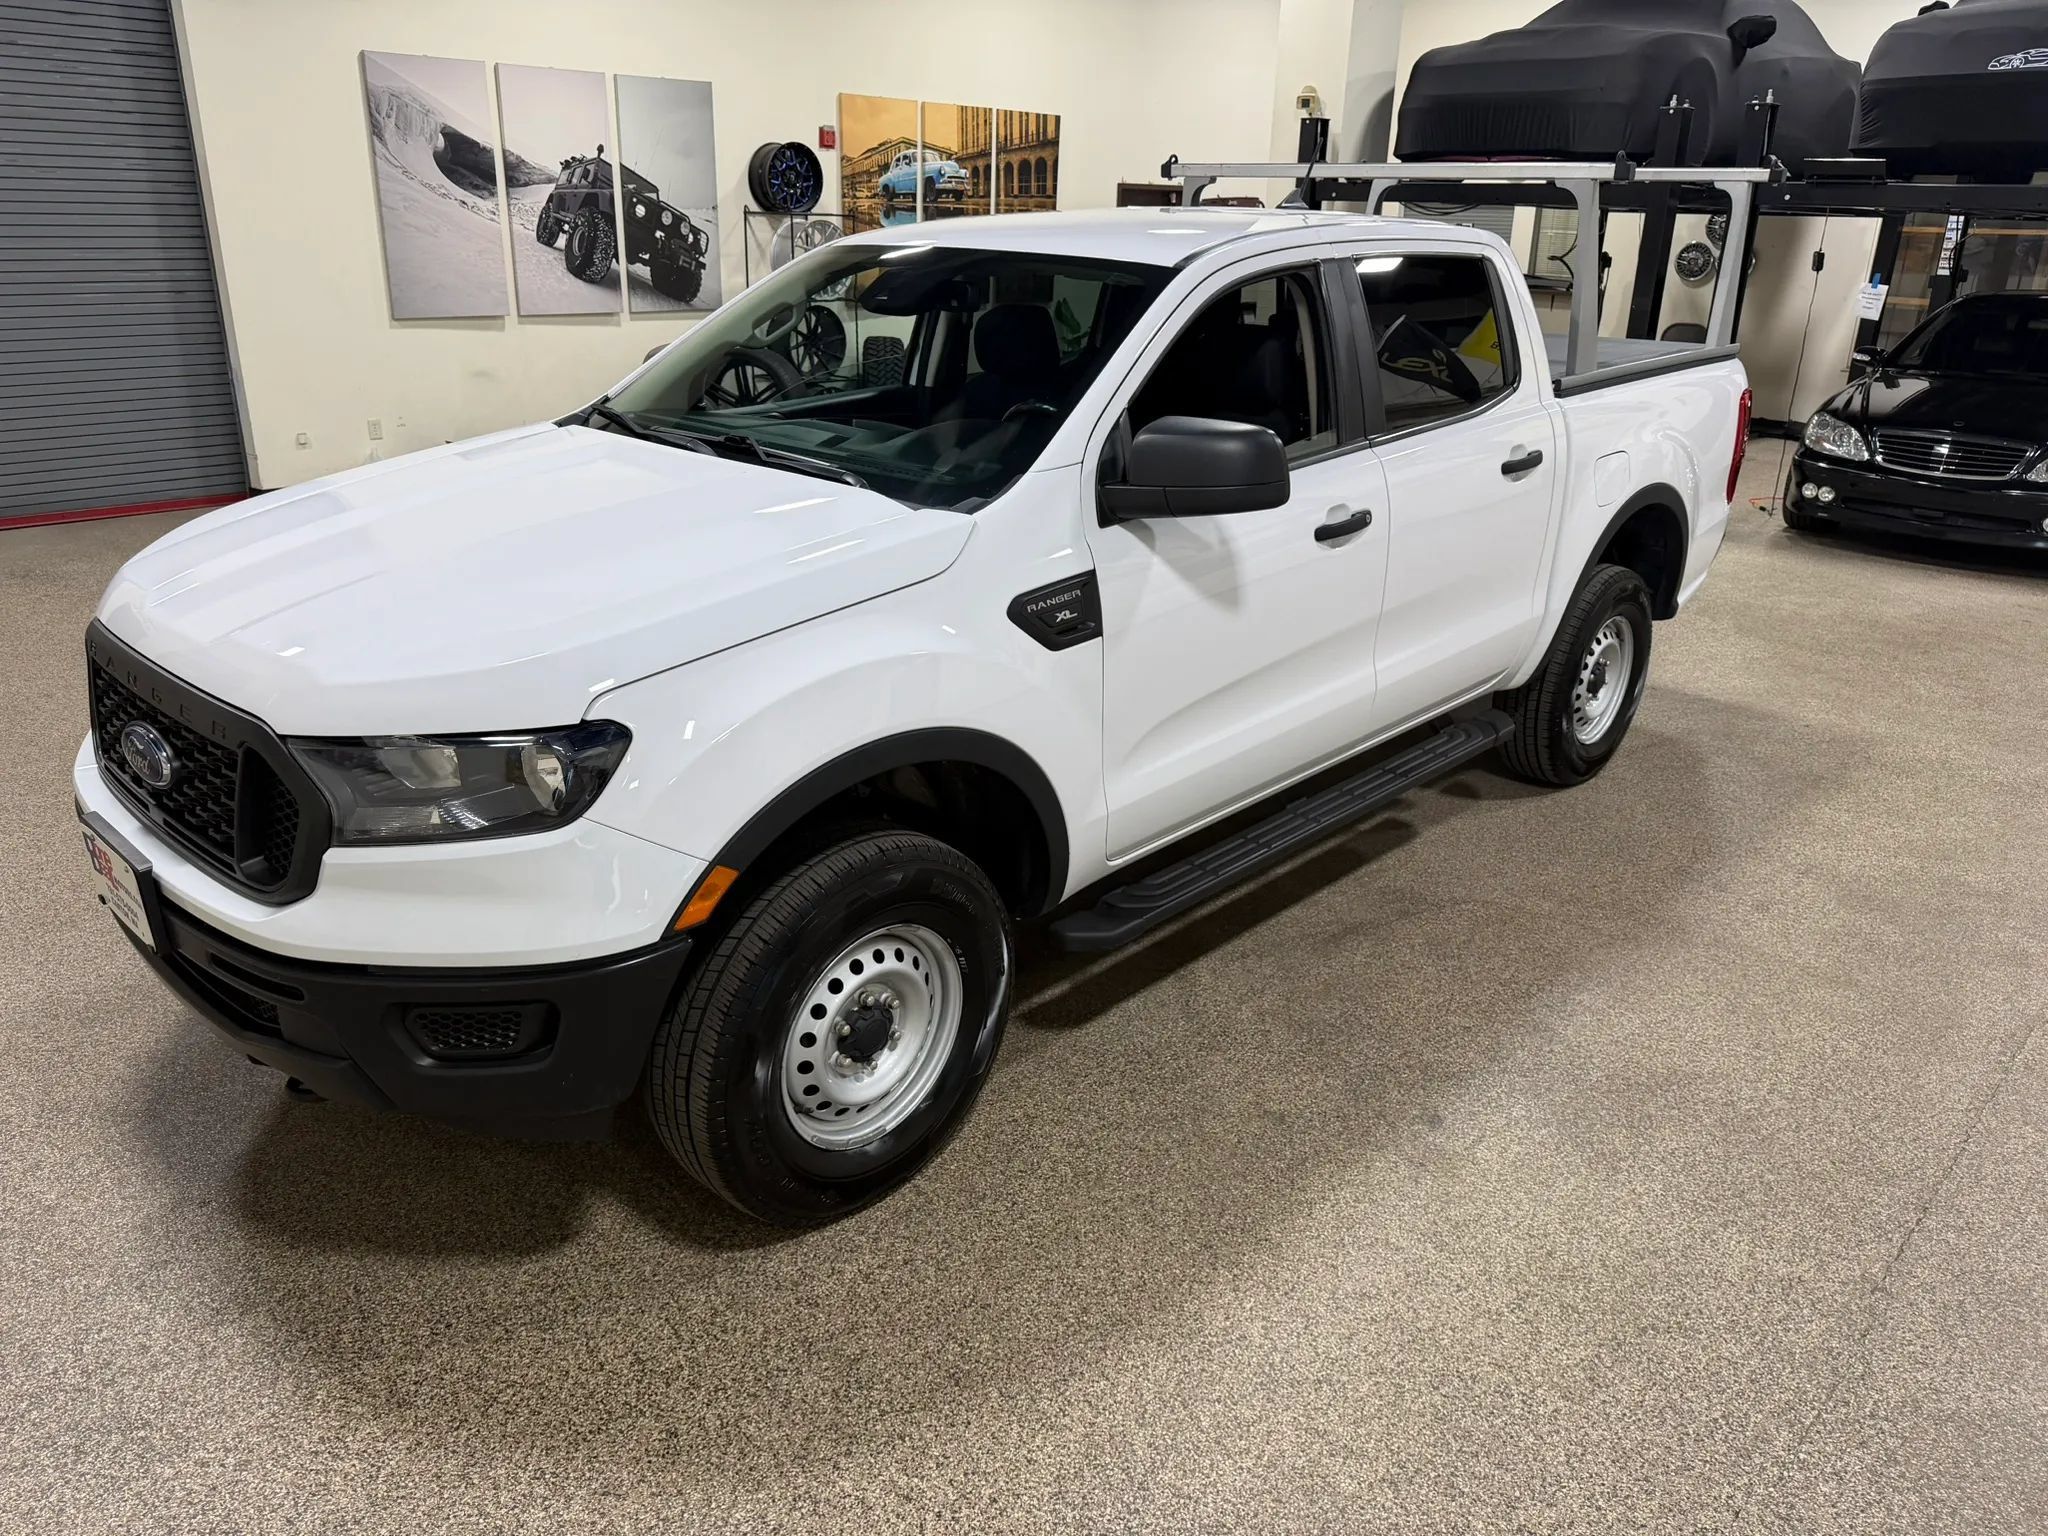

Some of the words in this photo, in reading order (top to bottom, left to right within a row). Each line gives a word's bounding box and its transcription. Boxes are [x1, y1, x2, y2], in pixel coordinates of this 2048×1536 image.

[1027, 589, 1081, 613] RANGER
[1054, 609, 1078, 623] XL
[91, 640, 226, 740] RANGER
